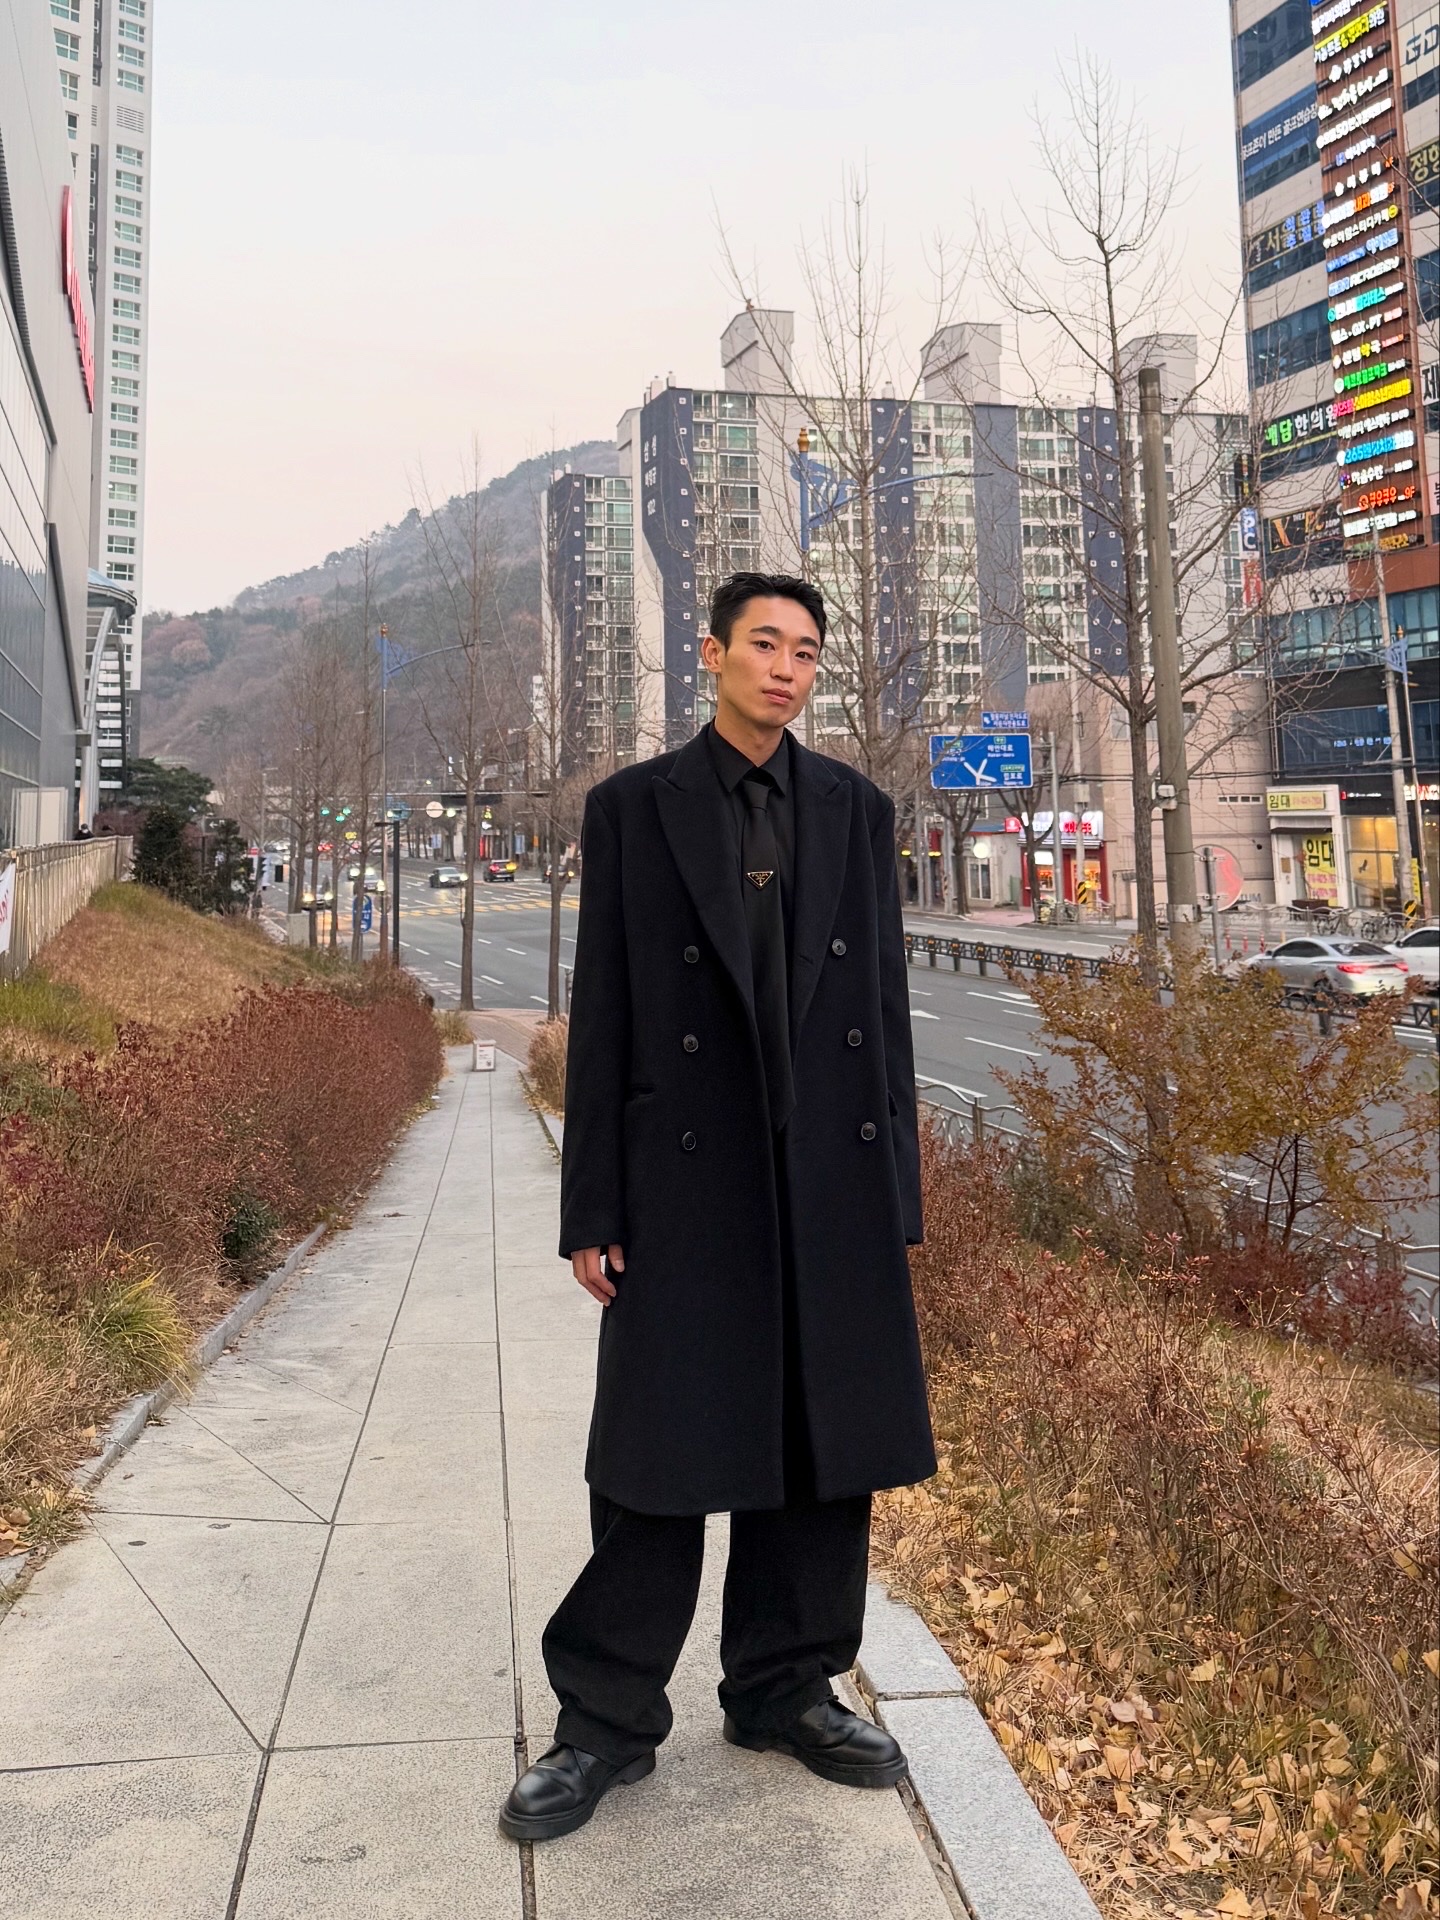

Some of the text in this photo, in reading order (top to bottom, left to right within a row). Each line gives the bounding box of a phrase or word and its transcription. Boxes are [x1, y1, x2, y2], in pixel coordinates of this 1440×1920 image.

[1369, 486, 1397, 508] 쿠우쿠우
[1269, 795, 1290, 809] 임대
[1306, 839, 1336, 868] 임대
